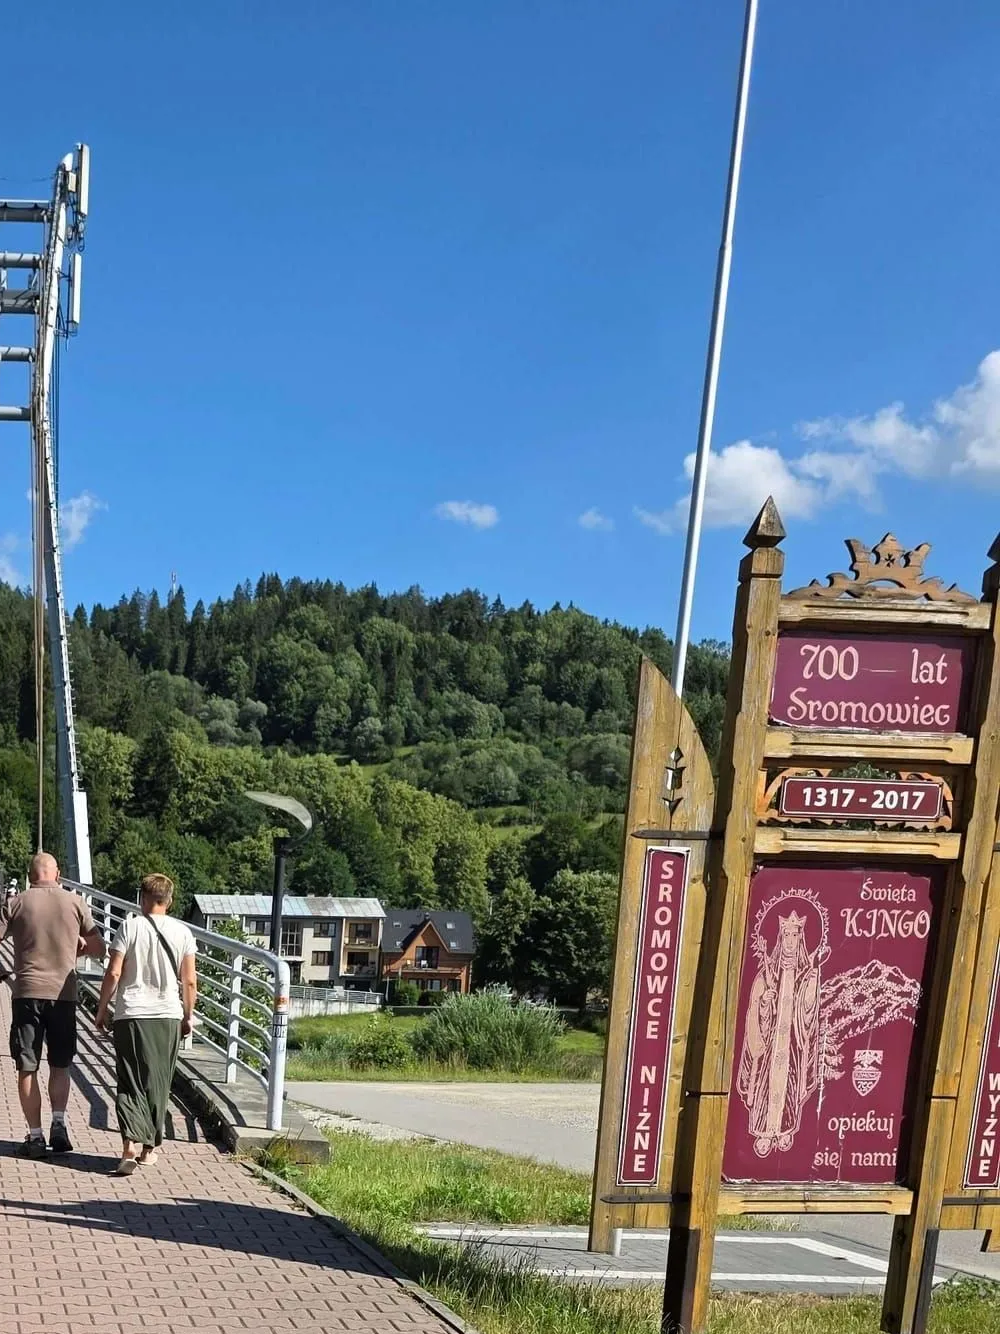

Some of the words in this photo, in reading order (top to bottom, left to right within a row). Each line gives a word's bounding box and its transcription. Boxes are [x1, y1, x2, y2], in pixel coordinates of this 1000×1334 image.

[800, 643, 859, 681] 700
[911, 648, 948, 685] lat
[787, 687, 950, 726] Sromowiec
[802, 787, 855, 808] 1317
[871, 789, 925, 810] 2017
[860, 877, 917, 904] Święta
[840, 907, 931, 940] KINGO
[646, 860, 675, 1040] SROMOWCE
[633, 1065, 656, 1172] NIŻNE
[828, 1109, 894, 1139] opiekuj
[813, 1147, 840, 1169] się
[851, 1147, 897, 1167] nami
